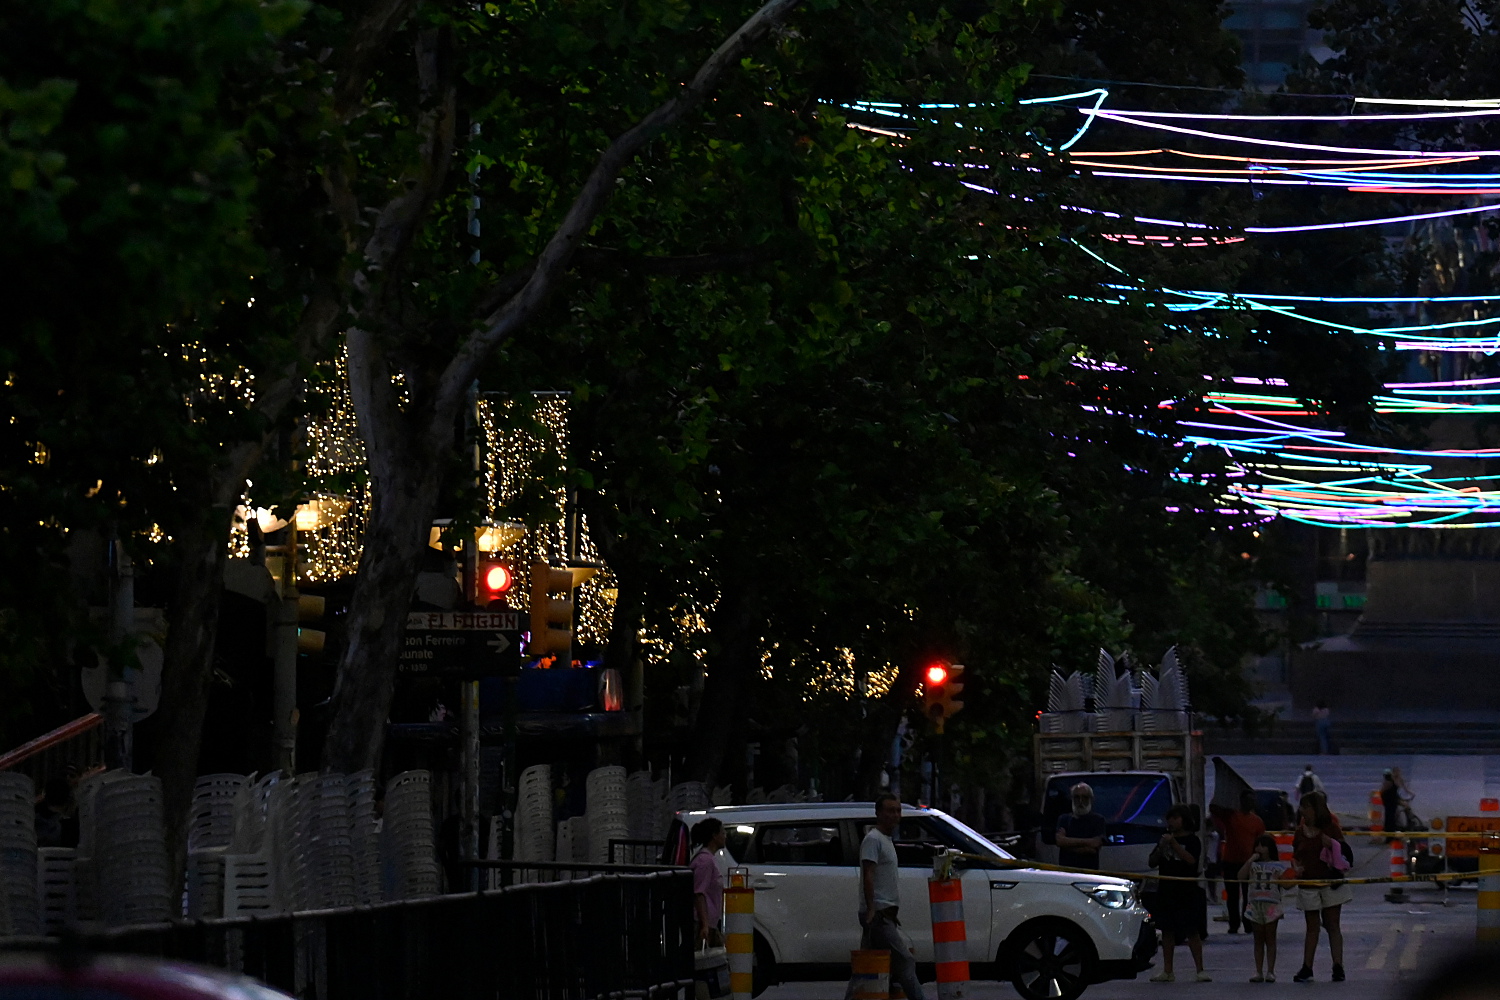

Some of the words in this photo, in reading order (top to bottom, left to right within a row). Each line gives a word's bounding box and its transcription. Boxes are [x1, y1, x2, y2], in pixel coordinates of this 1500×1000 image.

[428, 613, 448, 628] EL
[453, 613, 516, 628] FOGON
[425, 634, 466, 647] Ferreira
